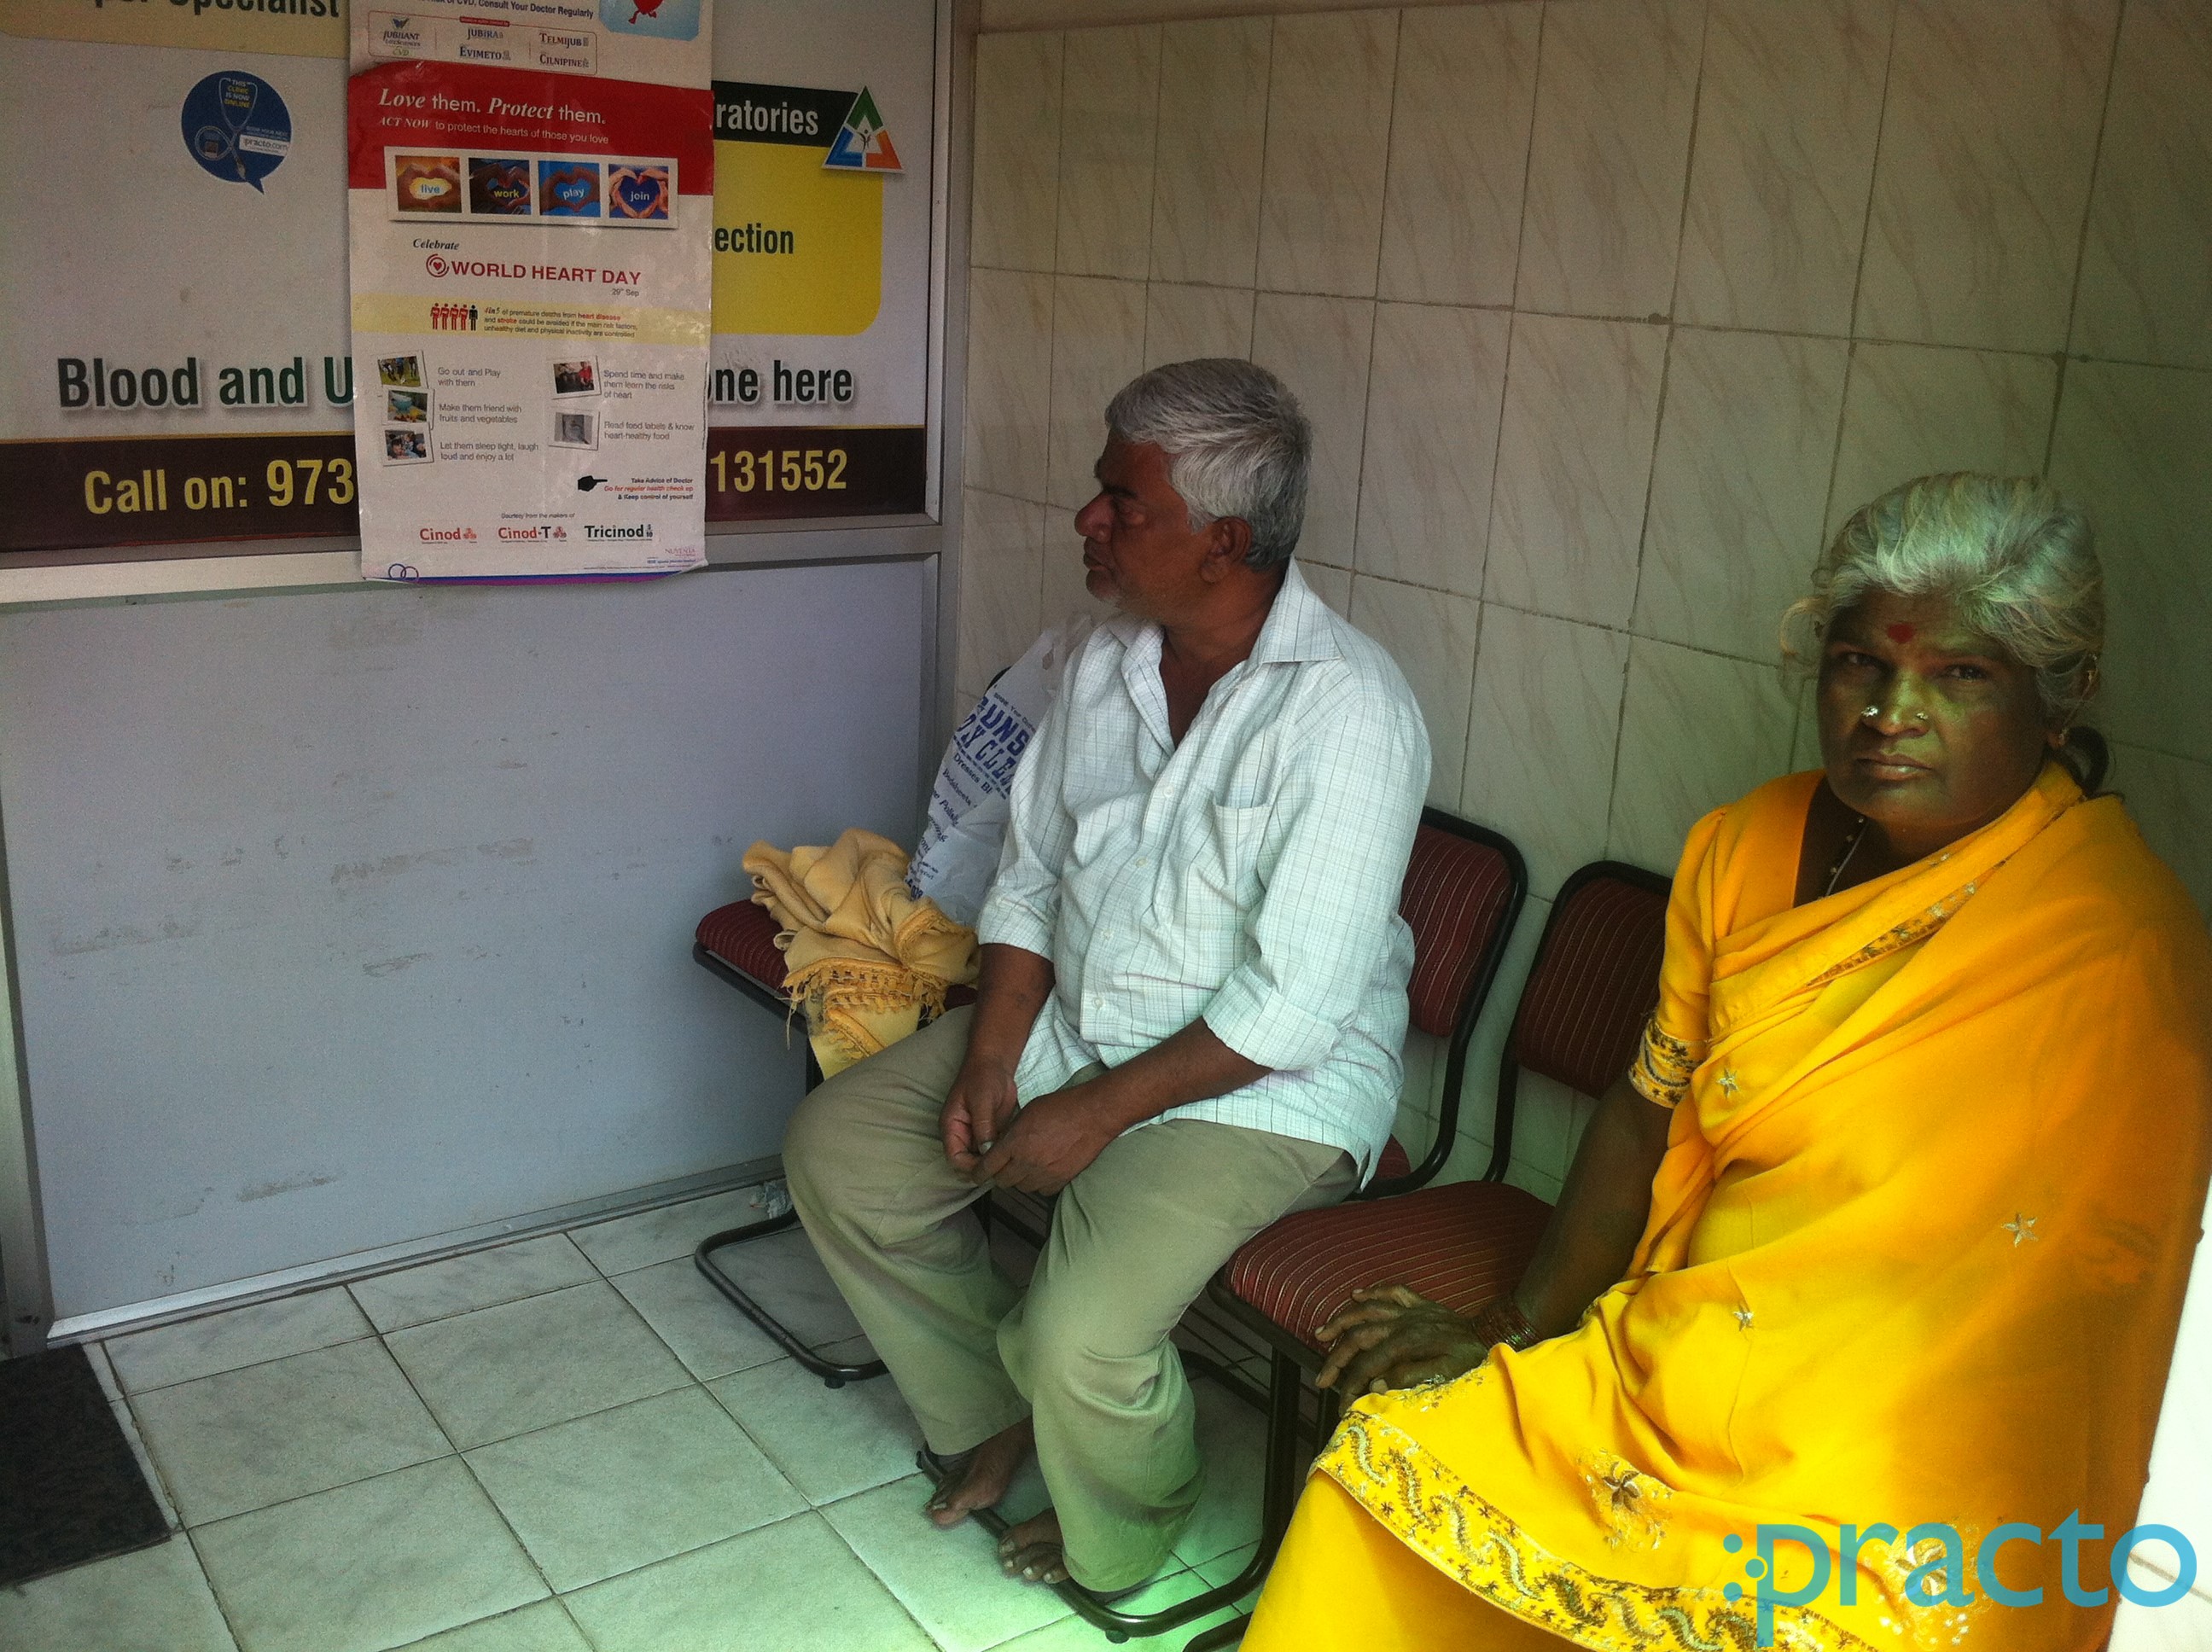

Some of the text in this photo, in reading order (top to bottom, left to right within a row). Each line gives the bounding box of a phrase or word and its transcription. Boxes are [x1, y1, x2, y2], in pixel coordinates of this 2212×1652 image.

[479, 0, 509, 9] Consult
[512, 2, 528, 11] Your
[530, 3, 556, 15] Doctor
[558, 7, 594, 19] Regularly
[379, 88, 606, 125] Love them. Protect them.
[716, 100, 819, 136] ratories
[380, 117, 609, 144] ACT NOW to protect the hearts of those you love
[422, 184, 440, 194] live
[494, 189, 520, 199] work
[563, 189, 585, 201] play
[631, 191, 650, 202] join
[714, 223, 795, 254] ection
[413, 239, 460, 251] Celebrate
[451, 261, 642, 285] WORLD HEART DAY
[626, 289, 640, 298] Sep
[597, 313, 621, 322] disease
[566, 329, 592, 337] inactivity
[438, 367, 451, 375] Go
[485, 368, 501, 379] Play
[604, 370, 629, 379] Spend
[631, 371, 647, 380] time
[57, 356, 853, 408] Blood and U ne here
[463, 404, 482, 412] them
[484, 404, 505, 413] friend
[507, 404, 522, 413] with
[461, 415, 475, 423] and
[477, 416, 518, 424] vegetables
[604, 433, 651, 441] heart-healthy
[454, 442, 474, 451] them
[475, 442, 497, 451] sleep
[518, 443, 539, 452] laugh
[476, 454, 496, 462] enjoy
[84, 449, 847, 514] Call on: 973 131552
[420, 527, 462, 541] Cinod
[498, 526, 551, 539] Cinod-T
[585, 525, 644, 538] Tricinod
[953, 753, 981, 783] Dresses
[942, 768, 971, 806] Bedsheets
